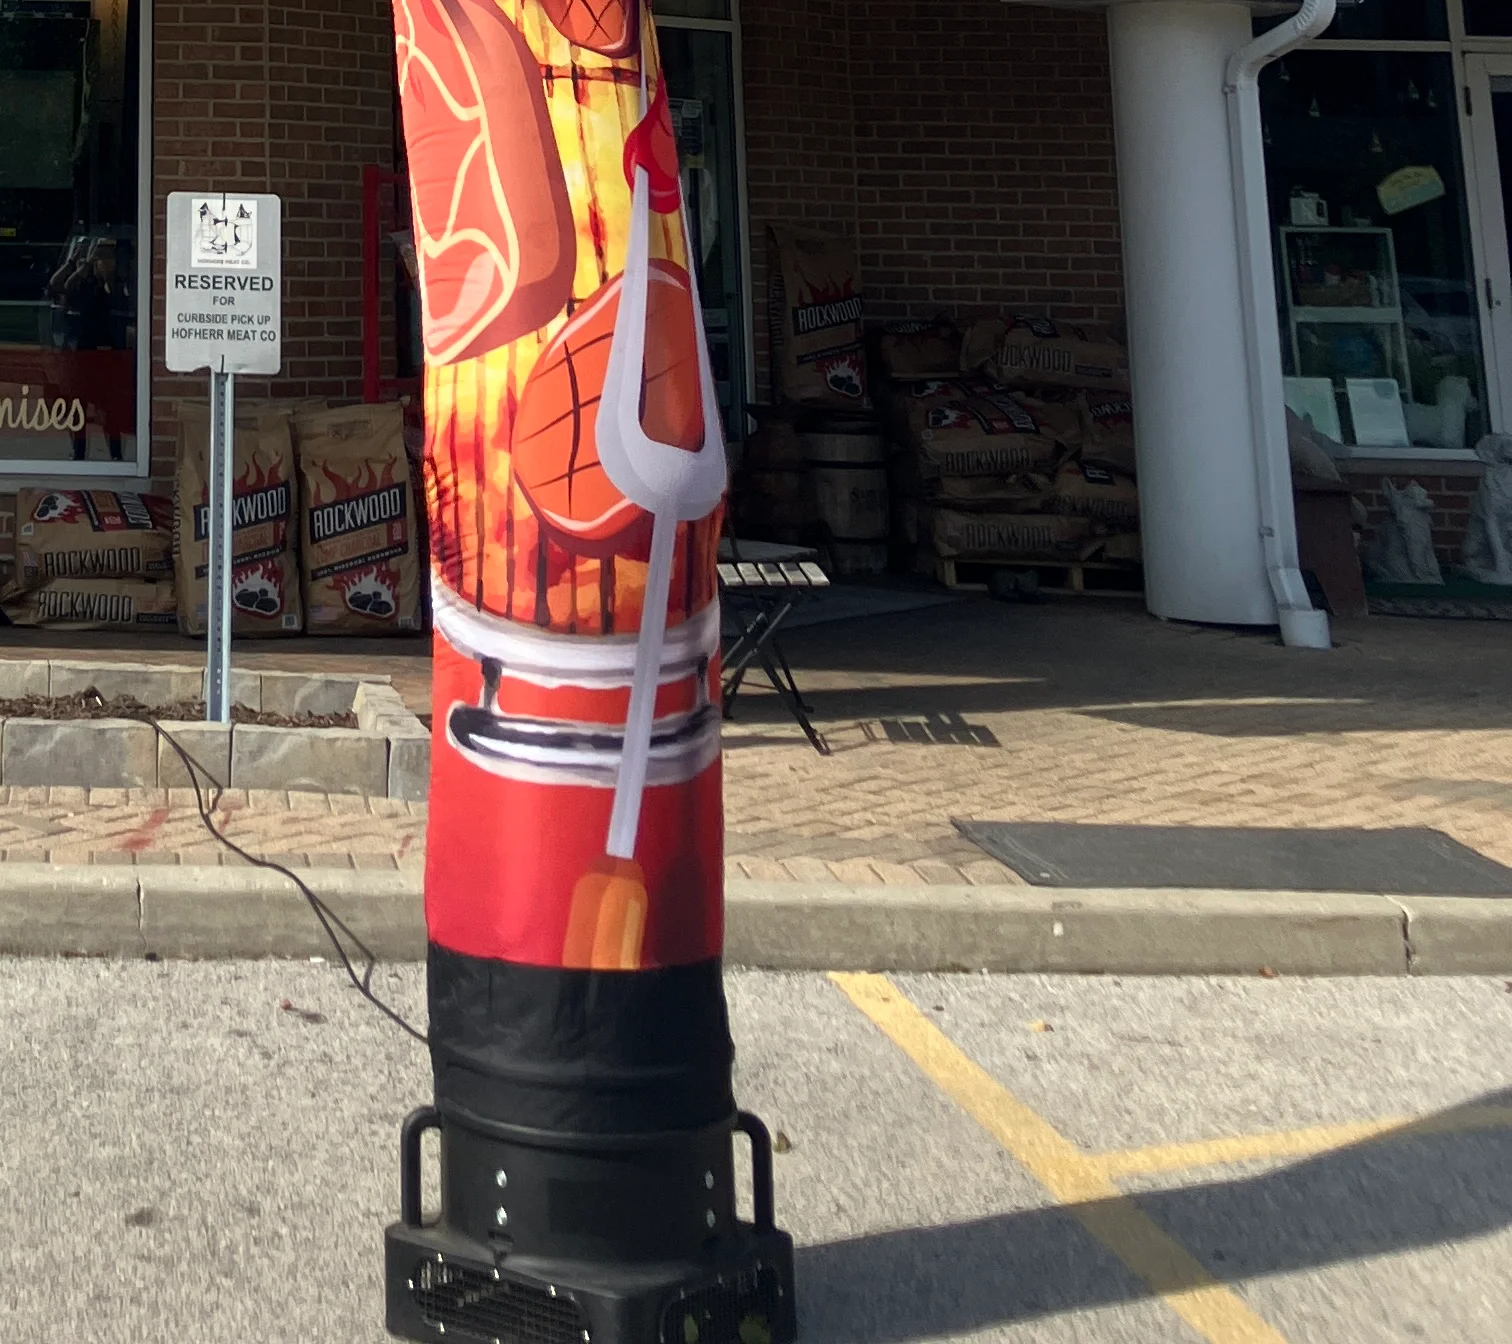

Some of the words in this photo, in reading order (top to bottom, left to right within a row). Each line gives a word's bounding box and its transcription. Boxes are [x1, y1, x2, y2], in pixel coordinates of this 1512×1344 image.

[175, 274, 274, 292] RESERVED
[212, 296, 236, 306] FOR
[177, 312, 228, 324] CURBSIDE
[231, 313, 254, 325] PICK
[257, 315, 271, 325] UP
[798, 297, 862, 332] ROCKWOOD
[171, 327, 224, 340] HOFHERR
[227, 329, 257, 342] MEAT
[260, 330, 276, 342] CO
[200, 487, 287, 536] RKWOOD
[314, 488, 401, 539] ROCKWOOD
[45, 547, 140, 577] ROCKWOOD
